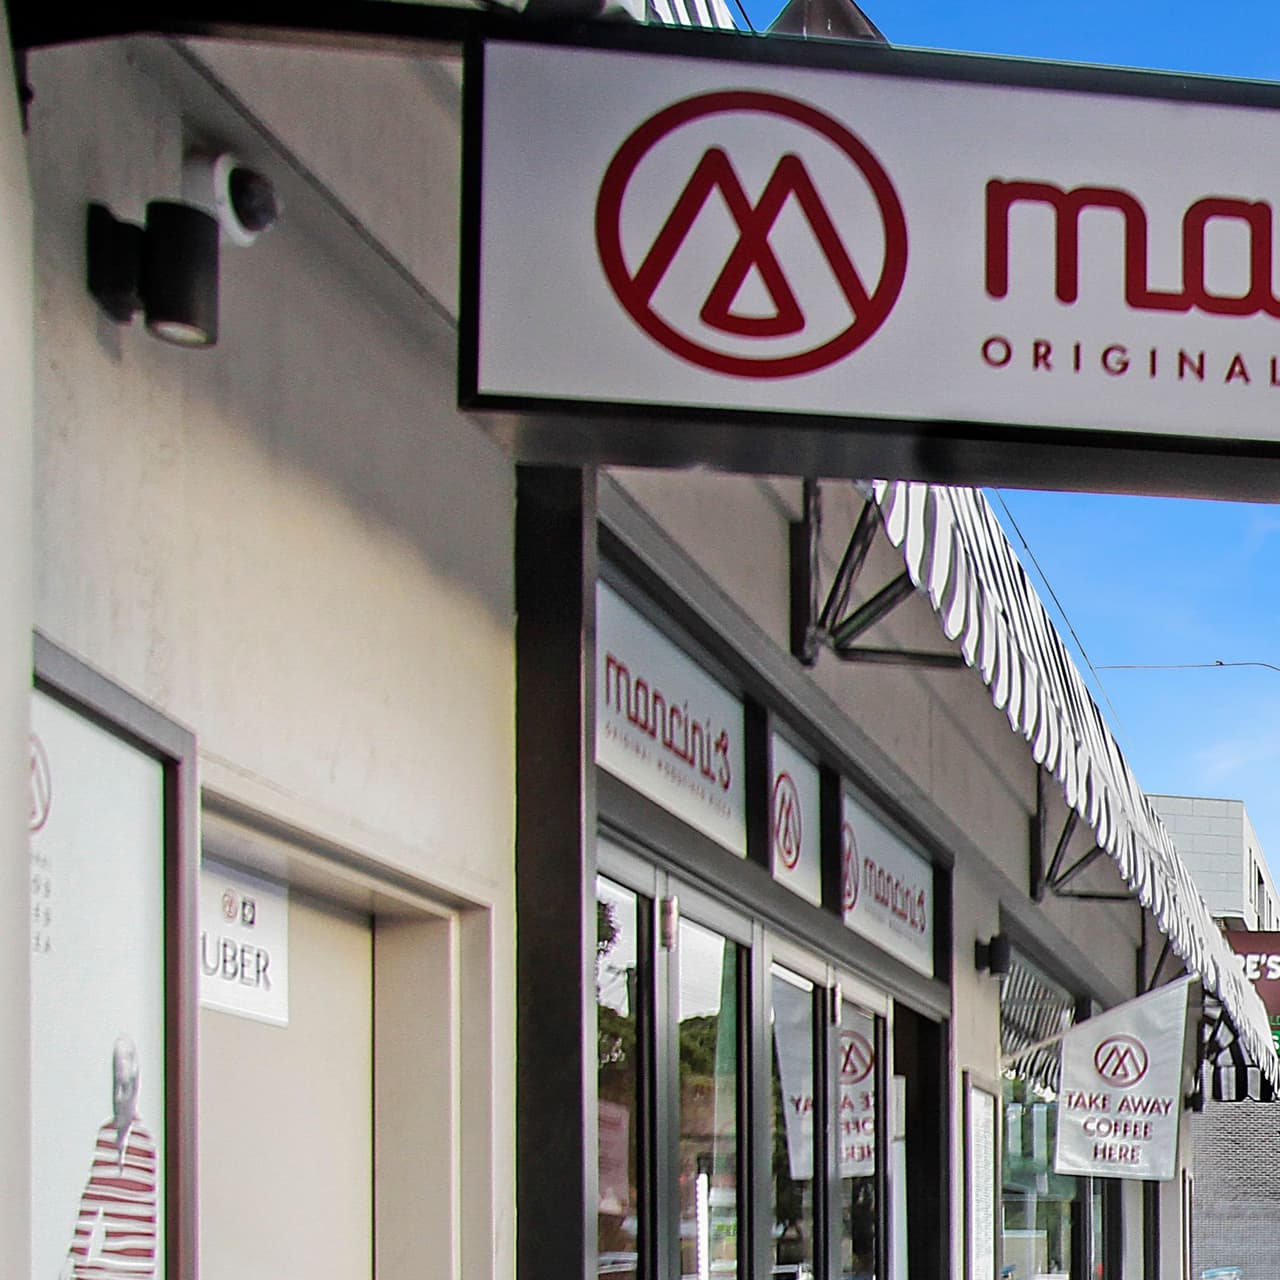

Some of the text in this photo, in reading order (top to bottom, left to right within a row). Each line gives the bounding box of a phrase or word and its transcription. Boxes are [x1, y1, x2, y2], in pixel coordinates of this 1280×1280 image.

[201, 931, 271, 991] UBER
[1065, 1091, 1173, 1116] TAKE AWAY
[1083, 1116, 1153, 1140] COFFEE
[1093, 1142, 1140, 1164] HERE
